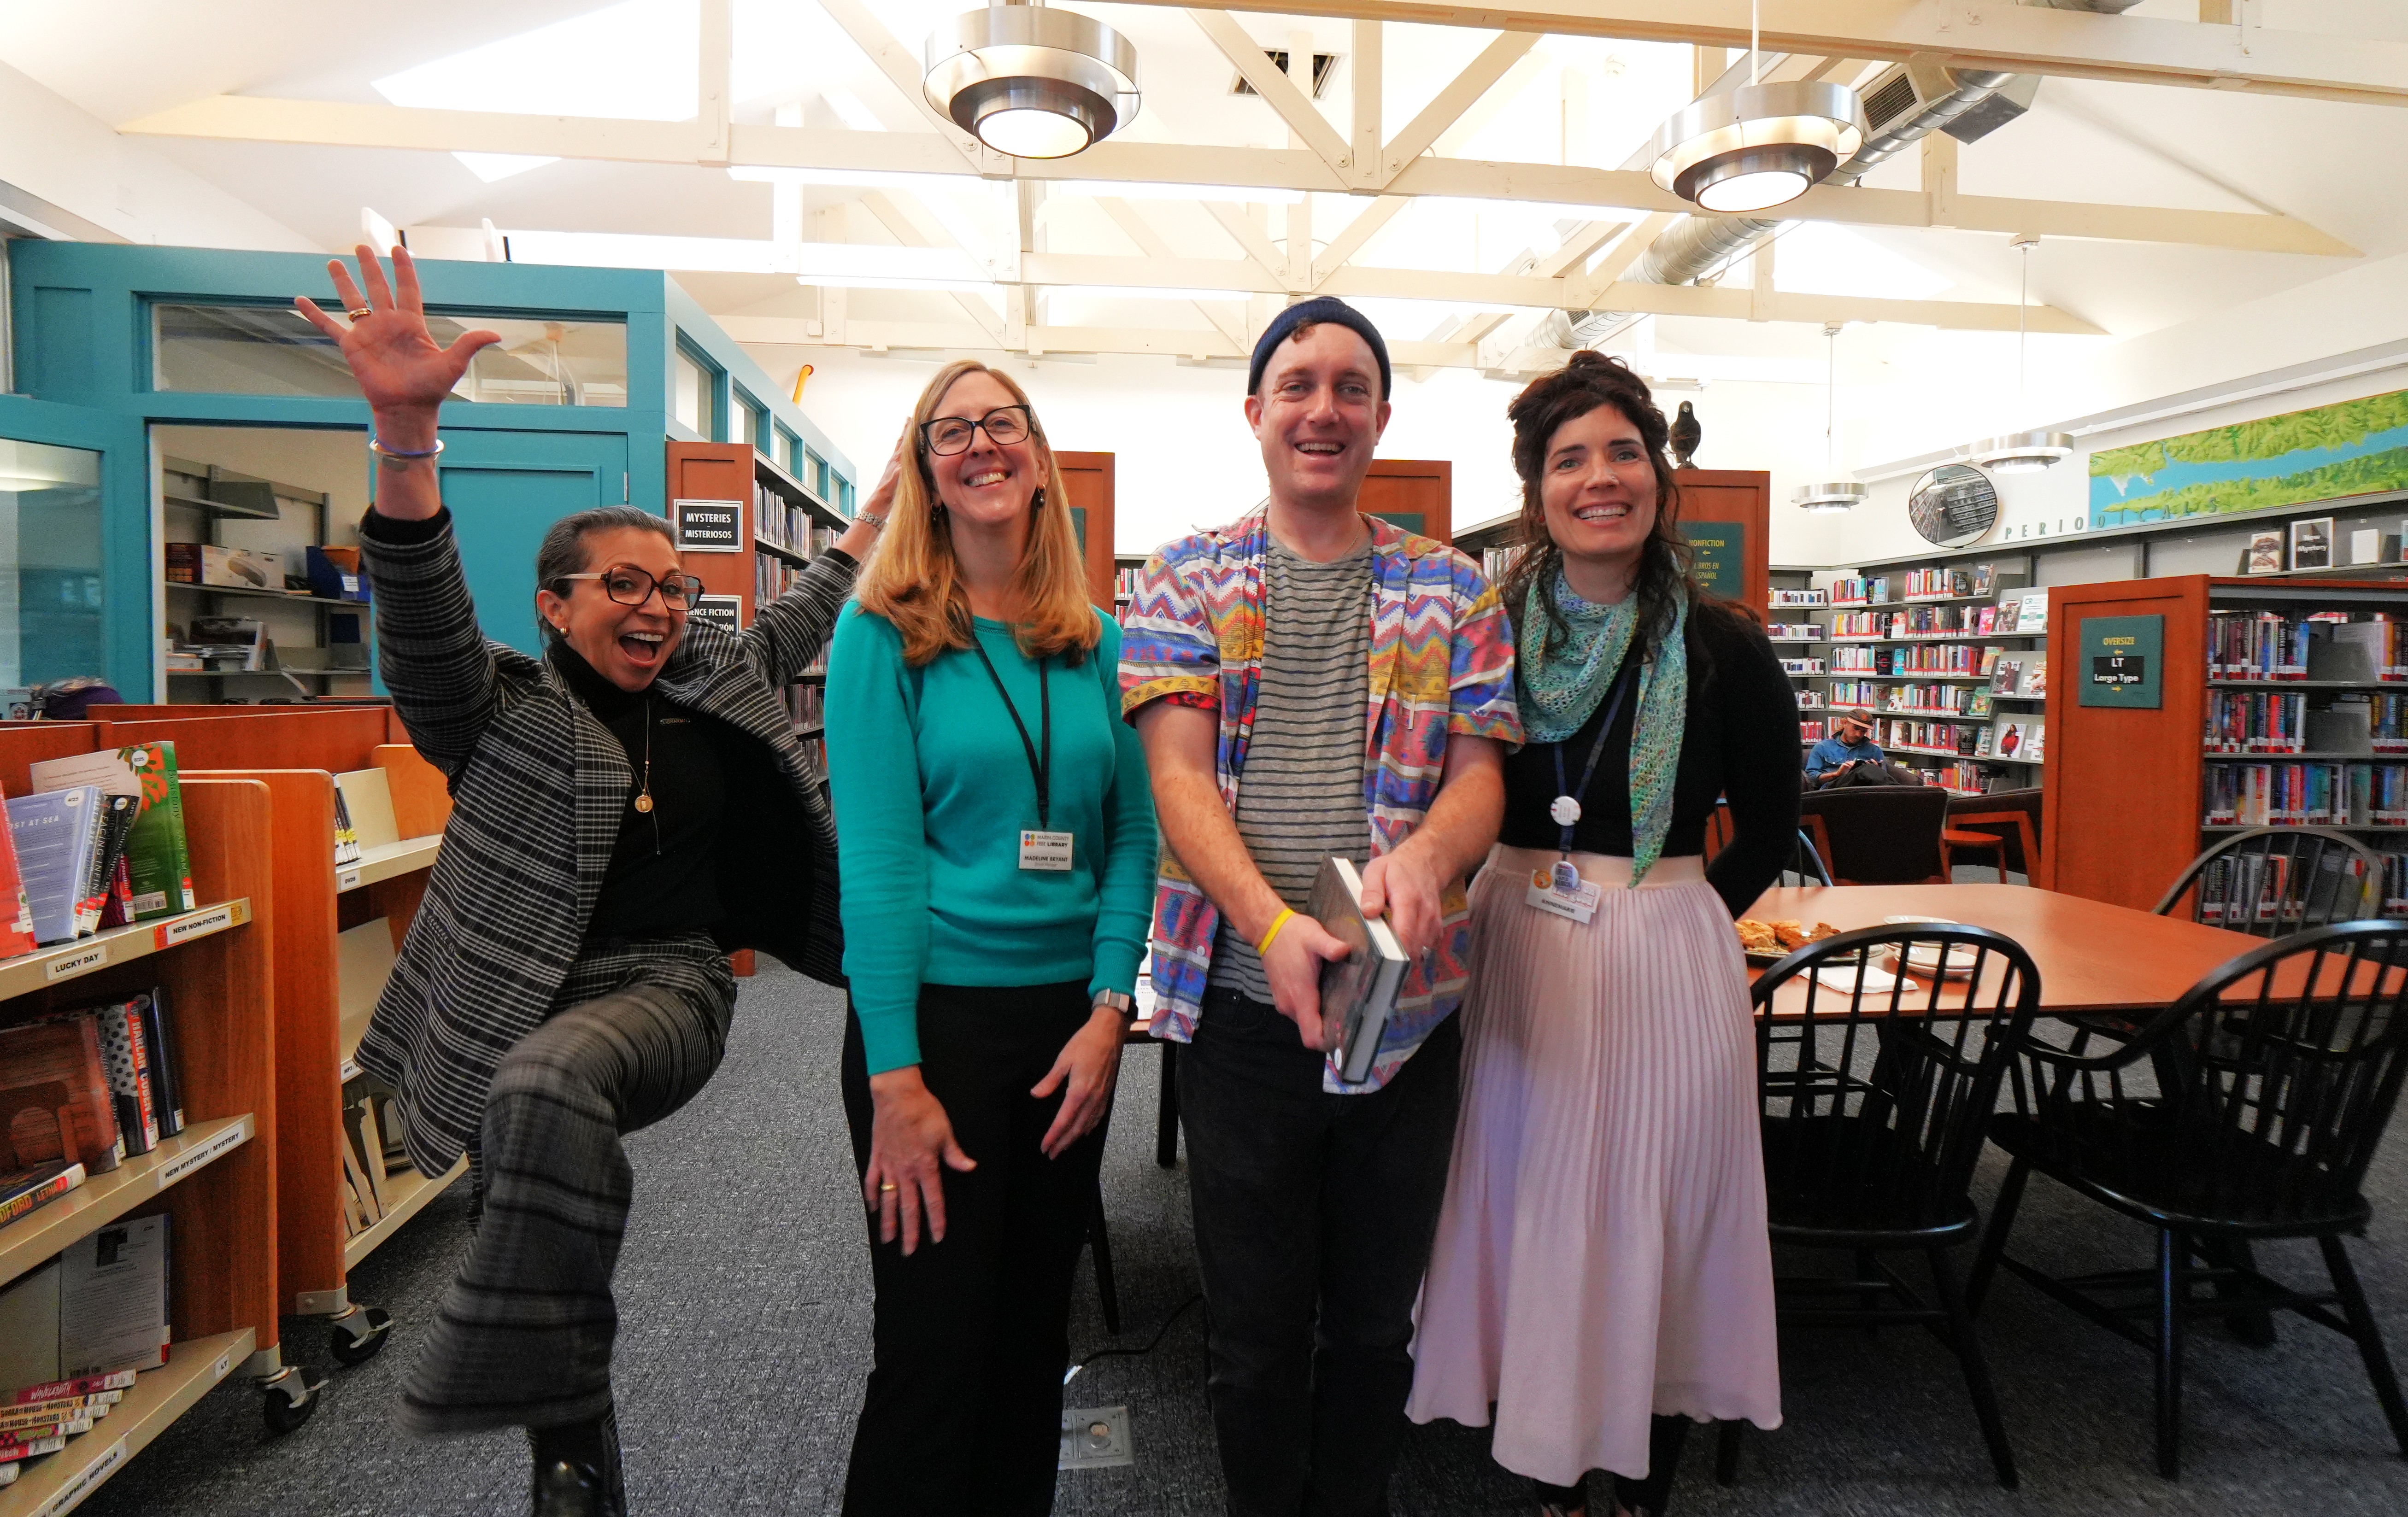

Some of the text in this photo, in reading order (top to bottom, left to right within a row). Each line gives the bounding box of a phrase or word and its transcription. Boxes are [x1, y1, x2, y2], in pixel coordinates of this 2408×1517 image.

[686, 513, 732, 523] MYSTERIES
[685, 530, 733, 539] MISTERIOSOS
[709, 608, 734, 616] FICTION
[2103, 637, 2135, 645] OVERSIZE
[2111, 657, 2125, 667] LT
[2094, 674, 2139, 684] Large Type
[42, 814, 59, 825] SEA
[173, 914, 226, 934] NEW NON-FICTION
[55, 953, 100, 973] LUCKY DAY
[132, 1022, 148, 1069] HARLAN
[164, 1166, 180, 1179] NEW
[180, 1149, 209, 1170] MYSTERY
[212, 1132, 240, 1152] MYSTERY
[221, 1360, 228, 1370] LT
[52, 1478, 87, 1513] GRAPHIC
[88, 1451, 118, 1481] NOVELS
